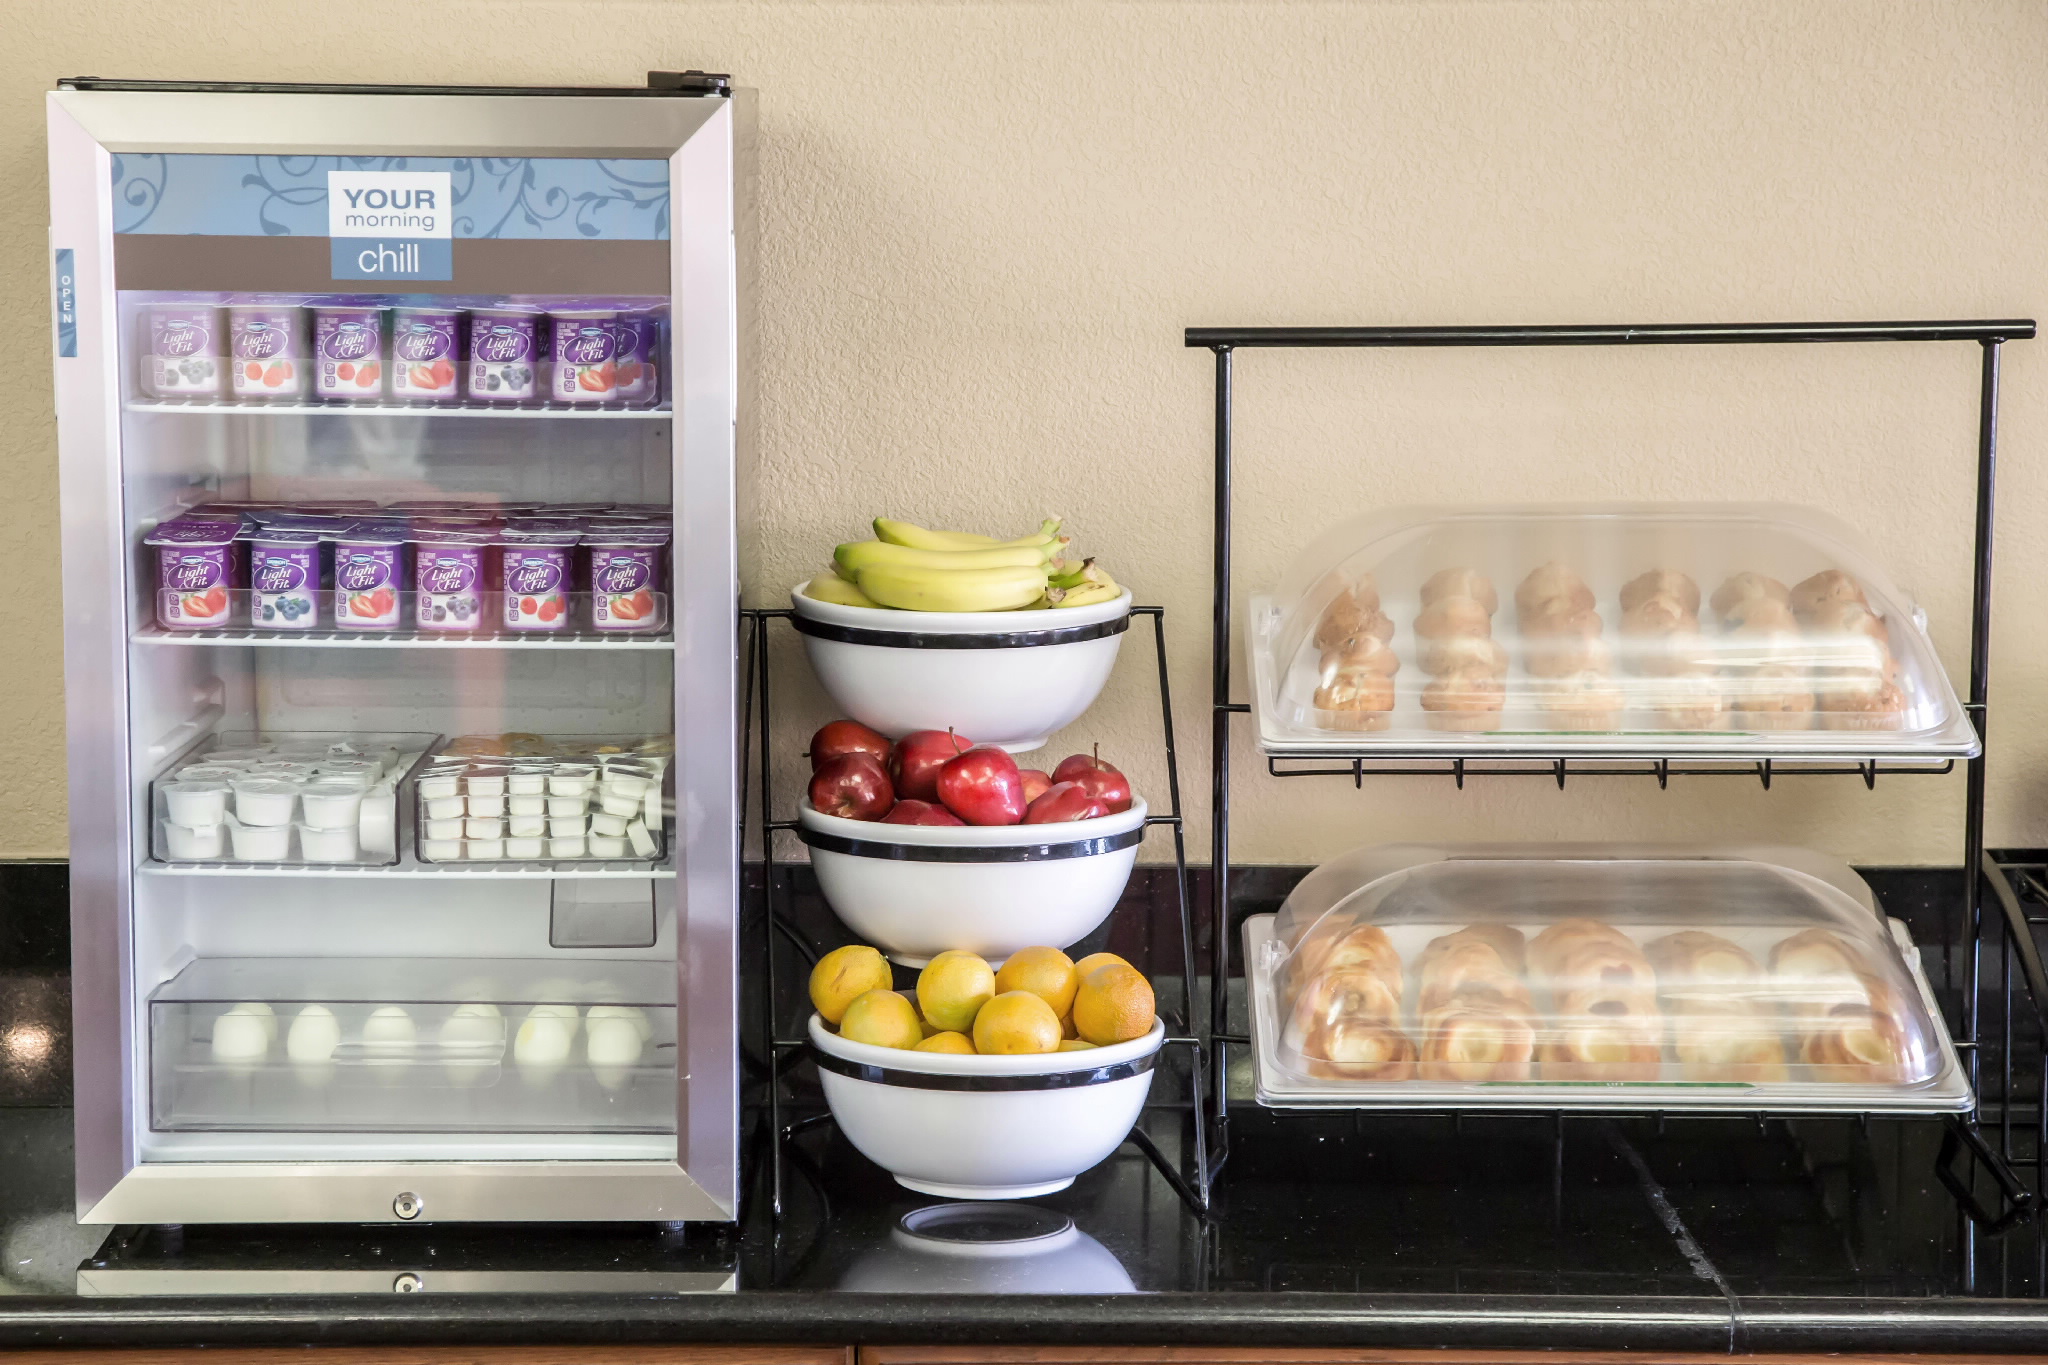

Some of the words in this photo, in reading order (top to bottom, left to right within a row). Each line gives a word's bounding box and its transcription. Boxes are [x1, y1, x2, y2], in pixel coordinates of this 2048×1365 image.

[343, 188, 436, 210] YOUR
[345, 212, 435, 232] morning
[358, 243, 420, 273] chill
[61, 275, 72, 324] OPEN
[164, 328, 194, 346] Light
[243, 330, 273, 348] Light
[335, 330, 366, 347] Light
[406, 332, 437, 349] Light
[487, 333, 518, 350] Light
[575, 335, 605, 352] Light
[255, 344, 270, 355] Fit
[348, 344, 363, 356] Fit
[418, 346, 433, 356] Fit
[499, 347, 514, 358] Fit
[589, 349, 602, 359] Fit
[178, 565, 207, 580] Light
[261, 567, 292, 582] Light
[346, 564, 377, 579] Light
[432, 568, 463, 582] Light
[519, 568, 549, 582] Light
[607, 568, 637, 581] Light
[191, 577, 205, 588] Fit
[273, 578, 288, 589] Fit
[358, 576, 373, 586] Fit
[444, 579, 459, 589] Fit
[531, 580, 545, 590] Fit
[619, 578, 633, 588] Fit
